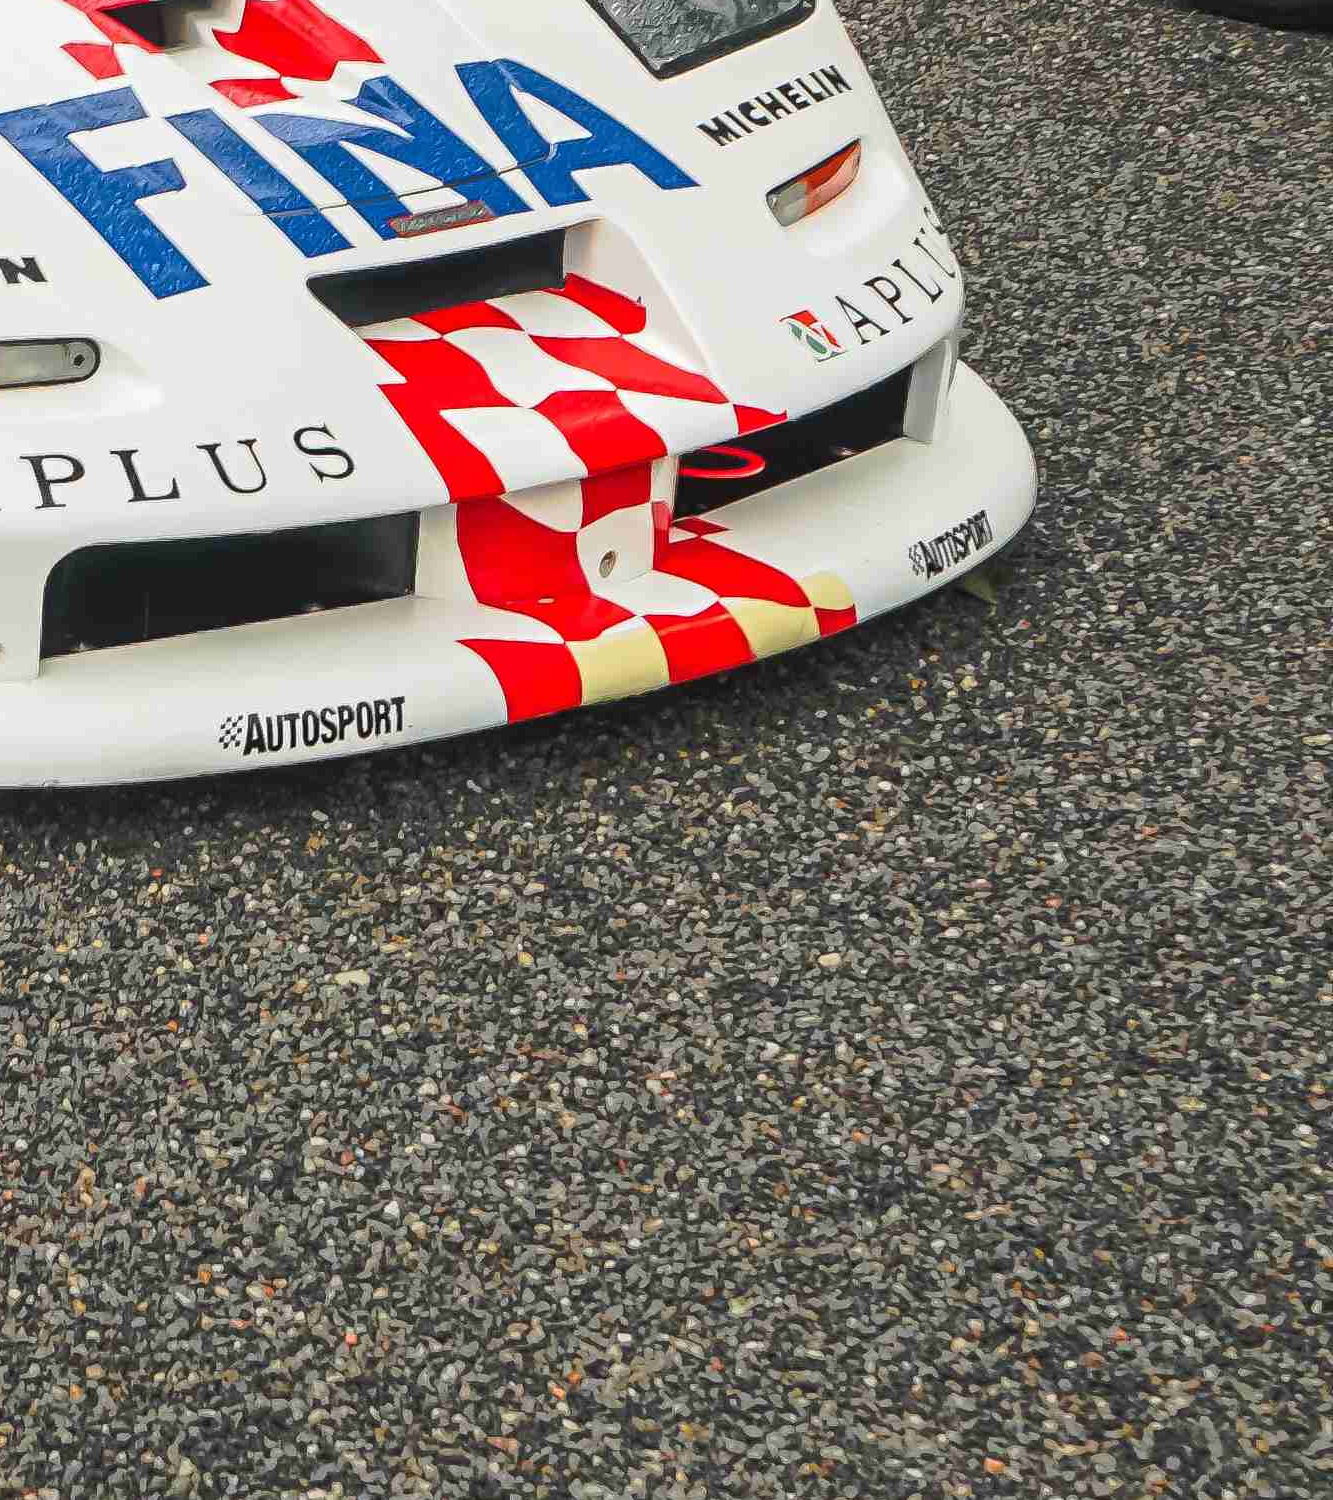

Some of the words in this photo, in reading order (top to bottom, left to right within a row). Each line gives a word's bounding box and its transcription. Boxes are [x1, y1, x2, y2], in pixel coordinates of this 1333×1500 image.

[697, 64, 853, 146] MICHELIN
[919, 508, 993, 580] AUTOSPORT
[242, 695, 406, 756] AUTOSPORT
